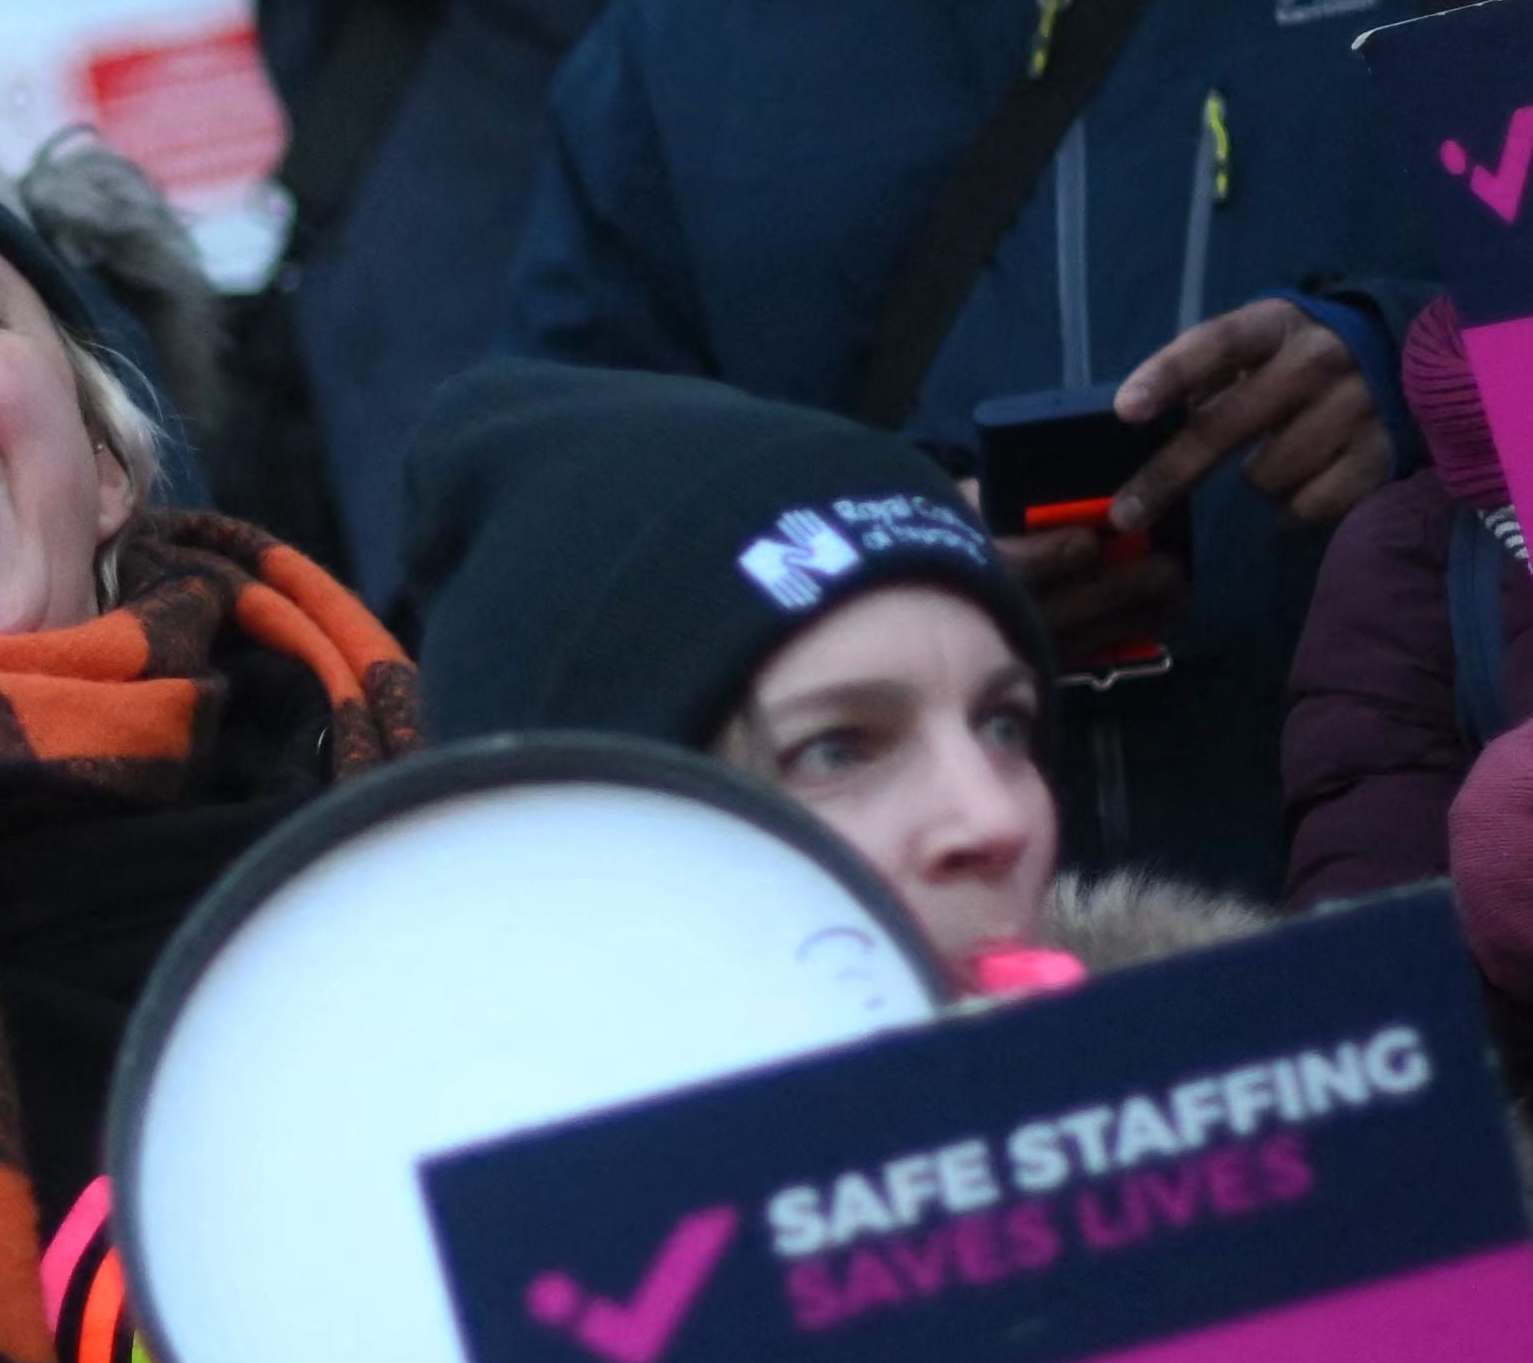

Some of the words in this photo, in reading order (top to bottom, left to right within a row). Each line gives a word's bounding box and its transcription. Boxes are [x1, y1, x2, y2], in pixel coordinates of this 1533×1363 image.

[767, 1140, 1000, 1258] SAFE
[1009, 1025, 1432, 1194] STAFFING
[783, 1206, 1062, 1334] SAVES
[1076, 1134, 1315, 1262] LIVES
